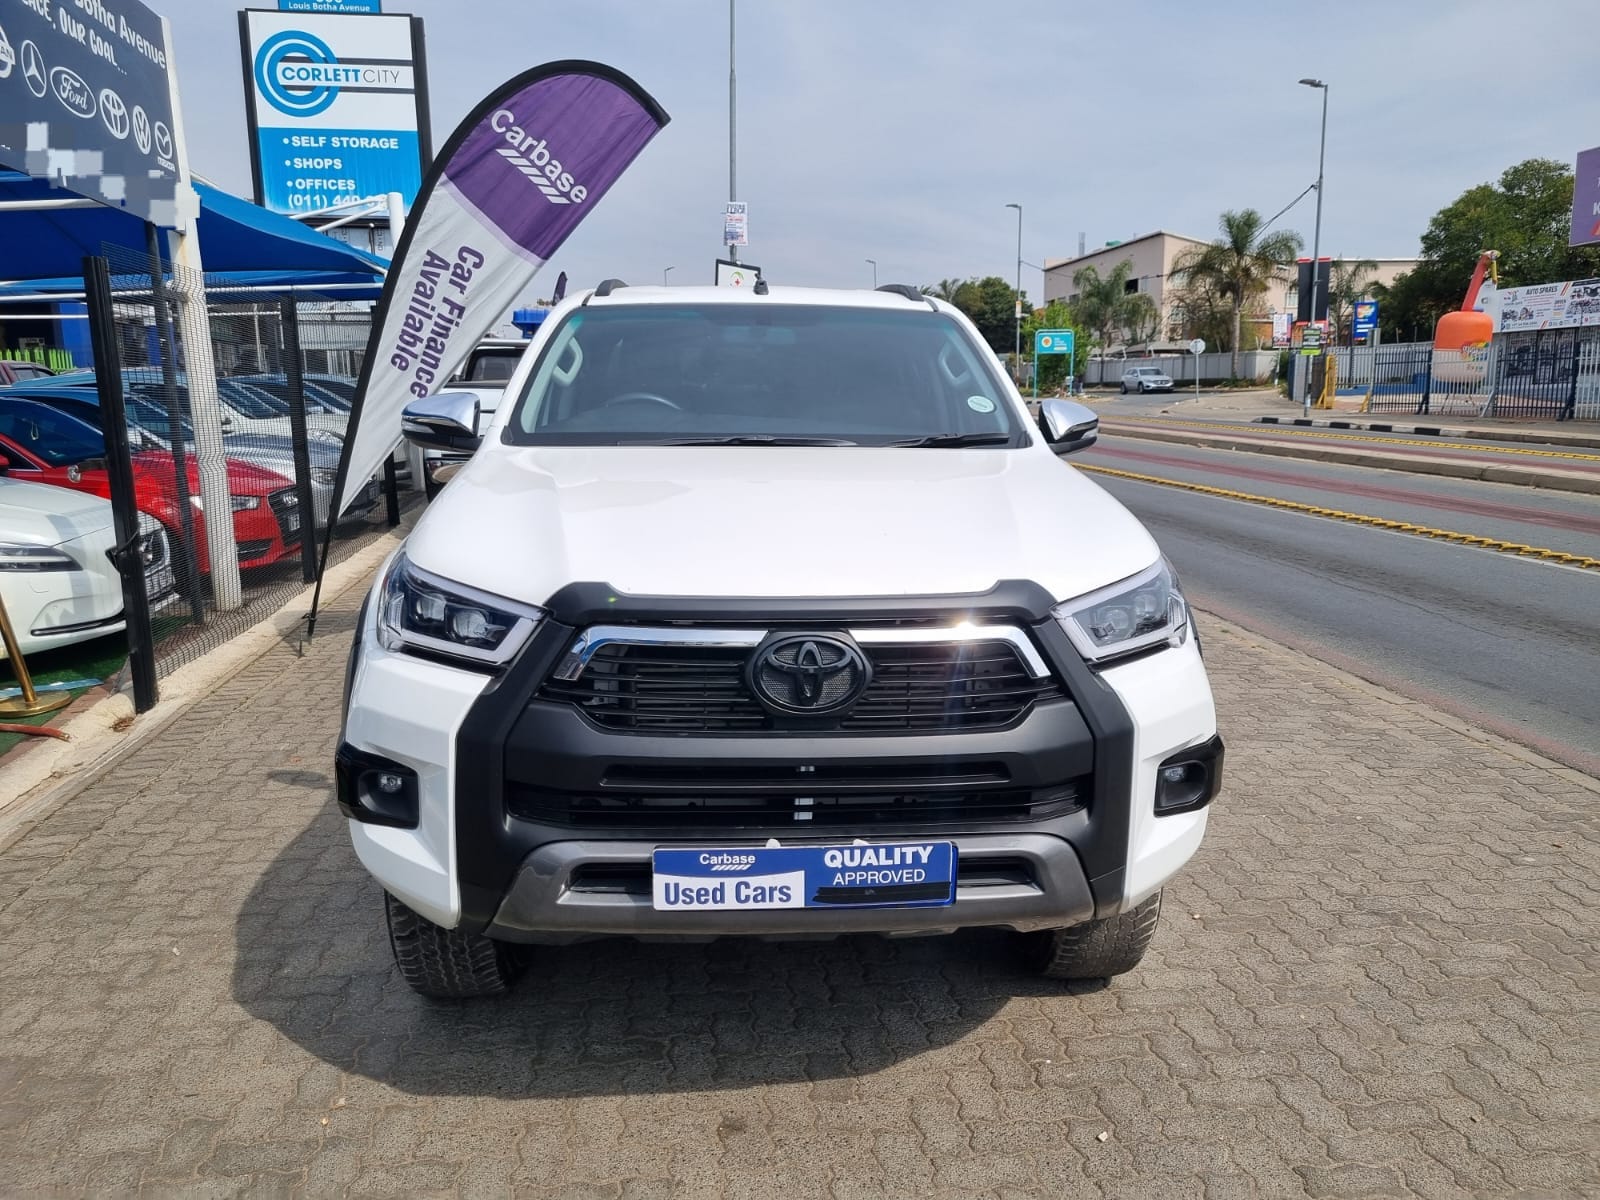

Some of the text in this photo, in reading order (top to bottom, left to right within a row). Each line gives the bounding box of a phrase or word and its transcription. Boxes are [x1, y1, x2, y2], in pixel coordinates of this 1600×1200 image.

[289, 2, 370, 12] Louis Botha Avenue
[59, 7, 86, 46] OUR
[120, 15, 166, 69] Avenue
[60, 74, 88, 110] Ford
[291, 136, 399, 149] SELF STORAGE
[293, 158, 343, 169] SHOPS
[491, 109, 588, 203] Carbase
[295, 179, 356, 190] OFFICES
[288, 193, 327, 209] (011)
[390, 249, 451, 372] Available
[409, 245, 485, 399] Car Finance
[699, 853, 756, 866] Carbase
[823, 846, 933, 869] QUALITY
[833, 869, 926, 886] APPROVED
[664, 881, 792, 905] Used Cars
